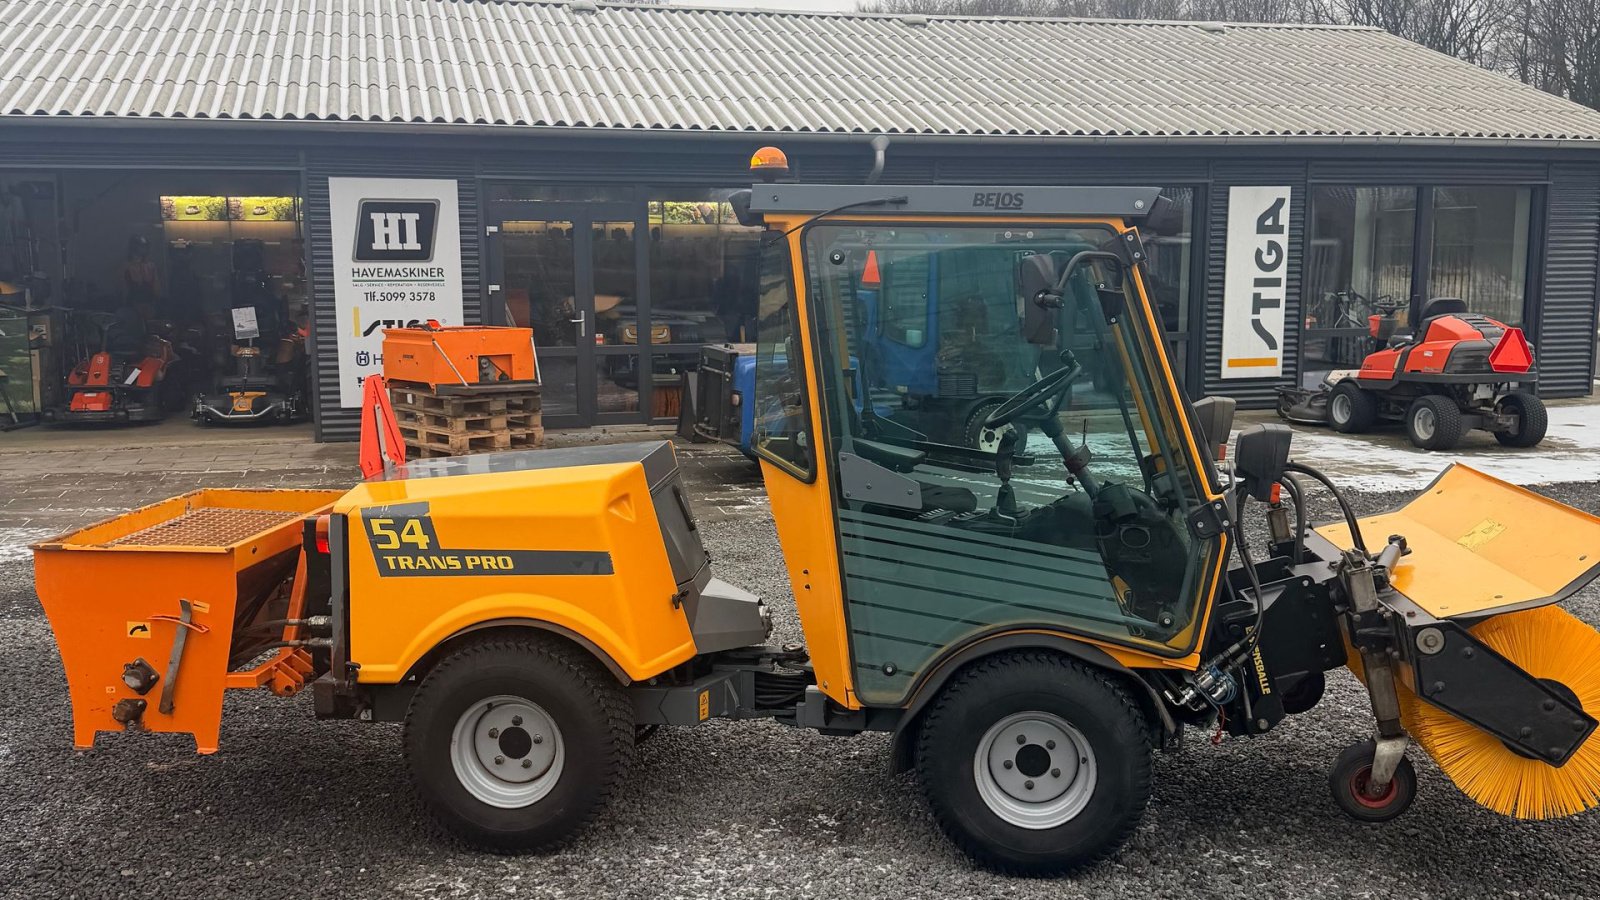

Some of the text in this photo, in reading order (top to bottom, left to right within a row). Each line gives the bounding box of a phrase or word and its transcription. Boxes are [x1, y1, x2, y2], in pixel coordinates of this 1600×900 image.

[972, 192, 1024, 210] BELOS
[370, 212, 421, 250] HI
[352, 268, 445, 278] HAVEMASKINER
[1251, 197, 1286, 350] STIGA
[409, 292, 436, 302] 3578
[370, 519, 429, 550] 54
[383, 556, 514, 570] TRANS PRO
